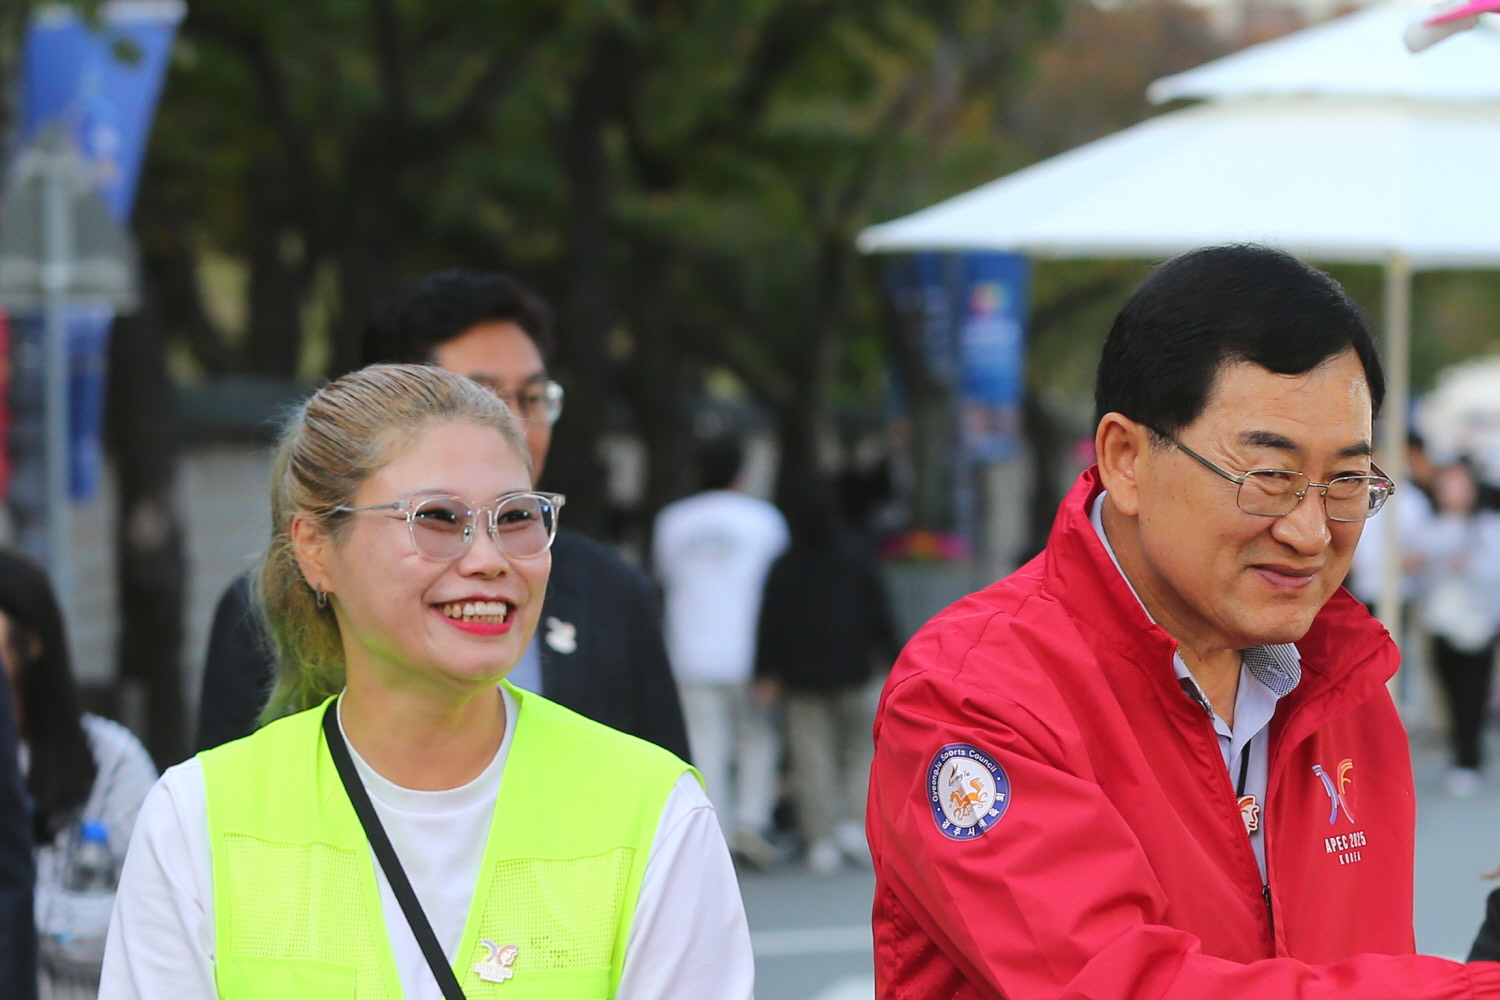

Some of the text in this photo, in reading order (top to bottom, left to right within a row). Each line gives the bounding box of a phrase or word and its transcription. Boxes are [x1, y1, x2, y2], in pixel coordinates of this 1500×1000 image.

[940, 749, 966, 761] Sports
[969, 749, 998, 773] Council
[1324, 830, 1367, 853] APEC 2025
[1338, 851, 1362, 865] KOREA
